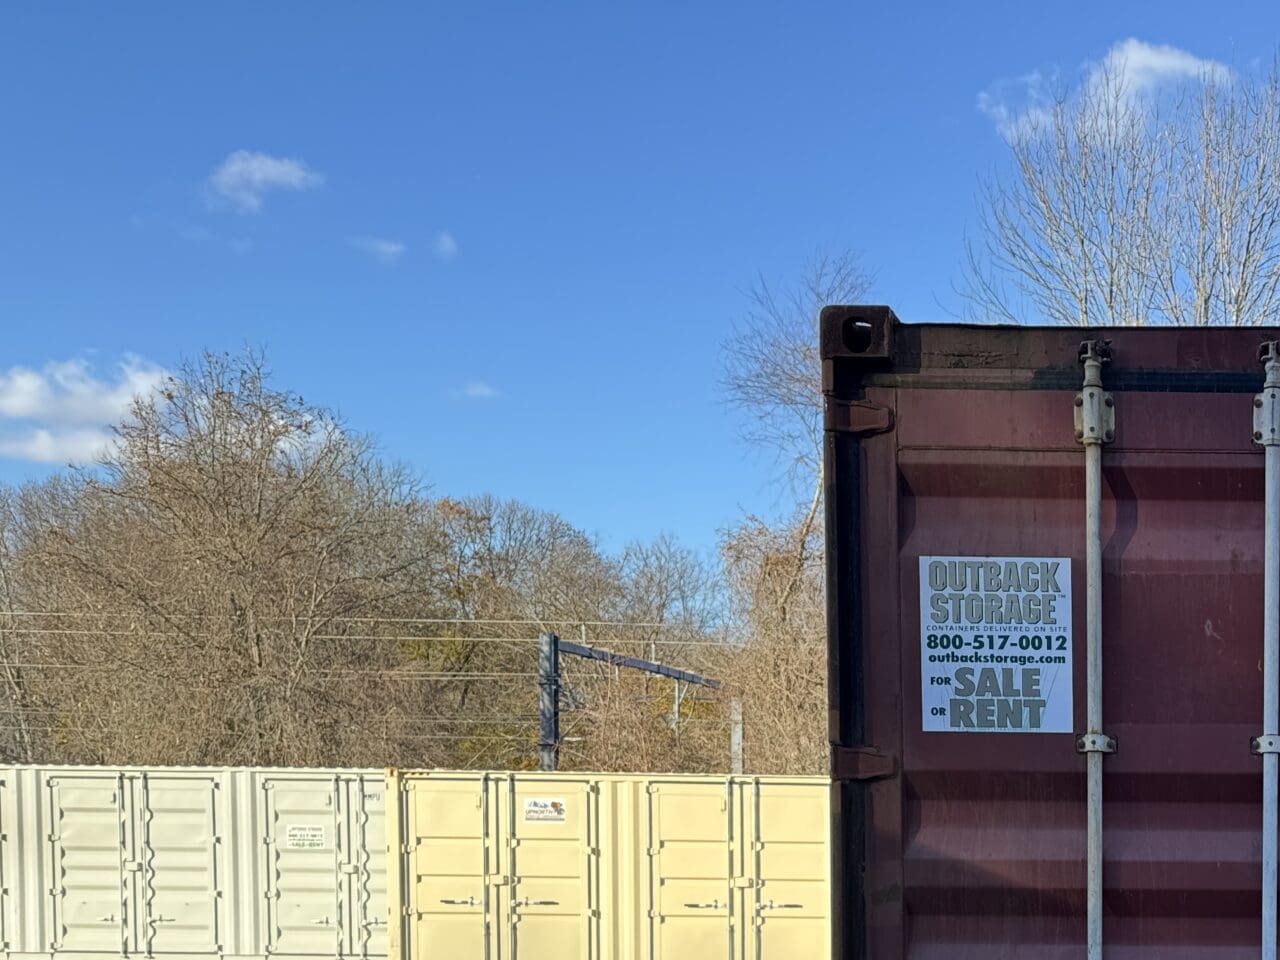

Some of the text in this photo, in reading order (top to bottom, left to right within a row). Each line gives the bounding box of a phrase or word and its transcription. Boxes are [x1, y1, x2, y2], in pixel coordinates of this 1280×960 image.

[929, 560, 1061, 592] OUTBACK
[930, 593, 1057, 625] STORAGE
[927, 634, 1067, 651] 800-517-0012
[928, 651, 1066, 665] outbackstorage.com
[930, 667, 1041, 697] FOR SALE
[931, 698, 1047, 729] OR RENT
